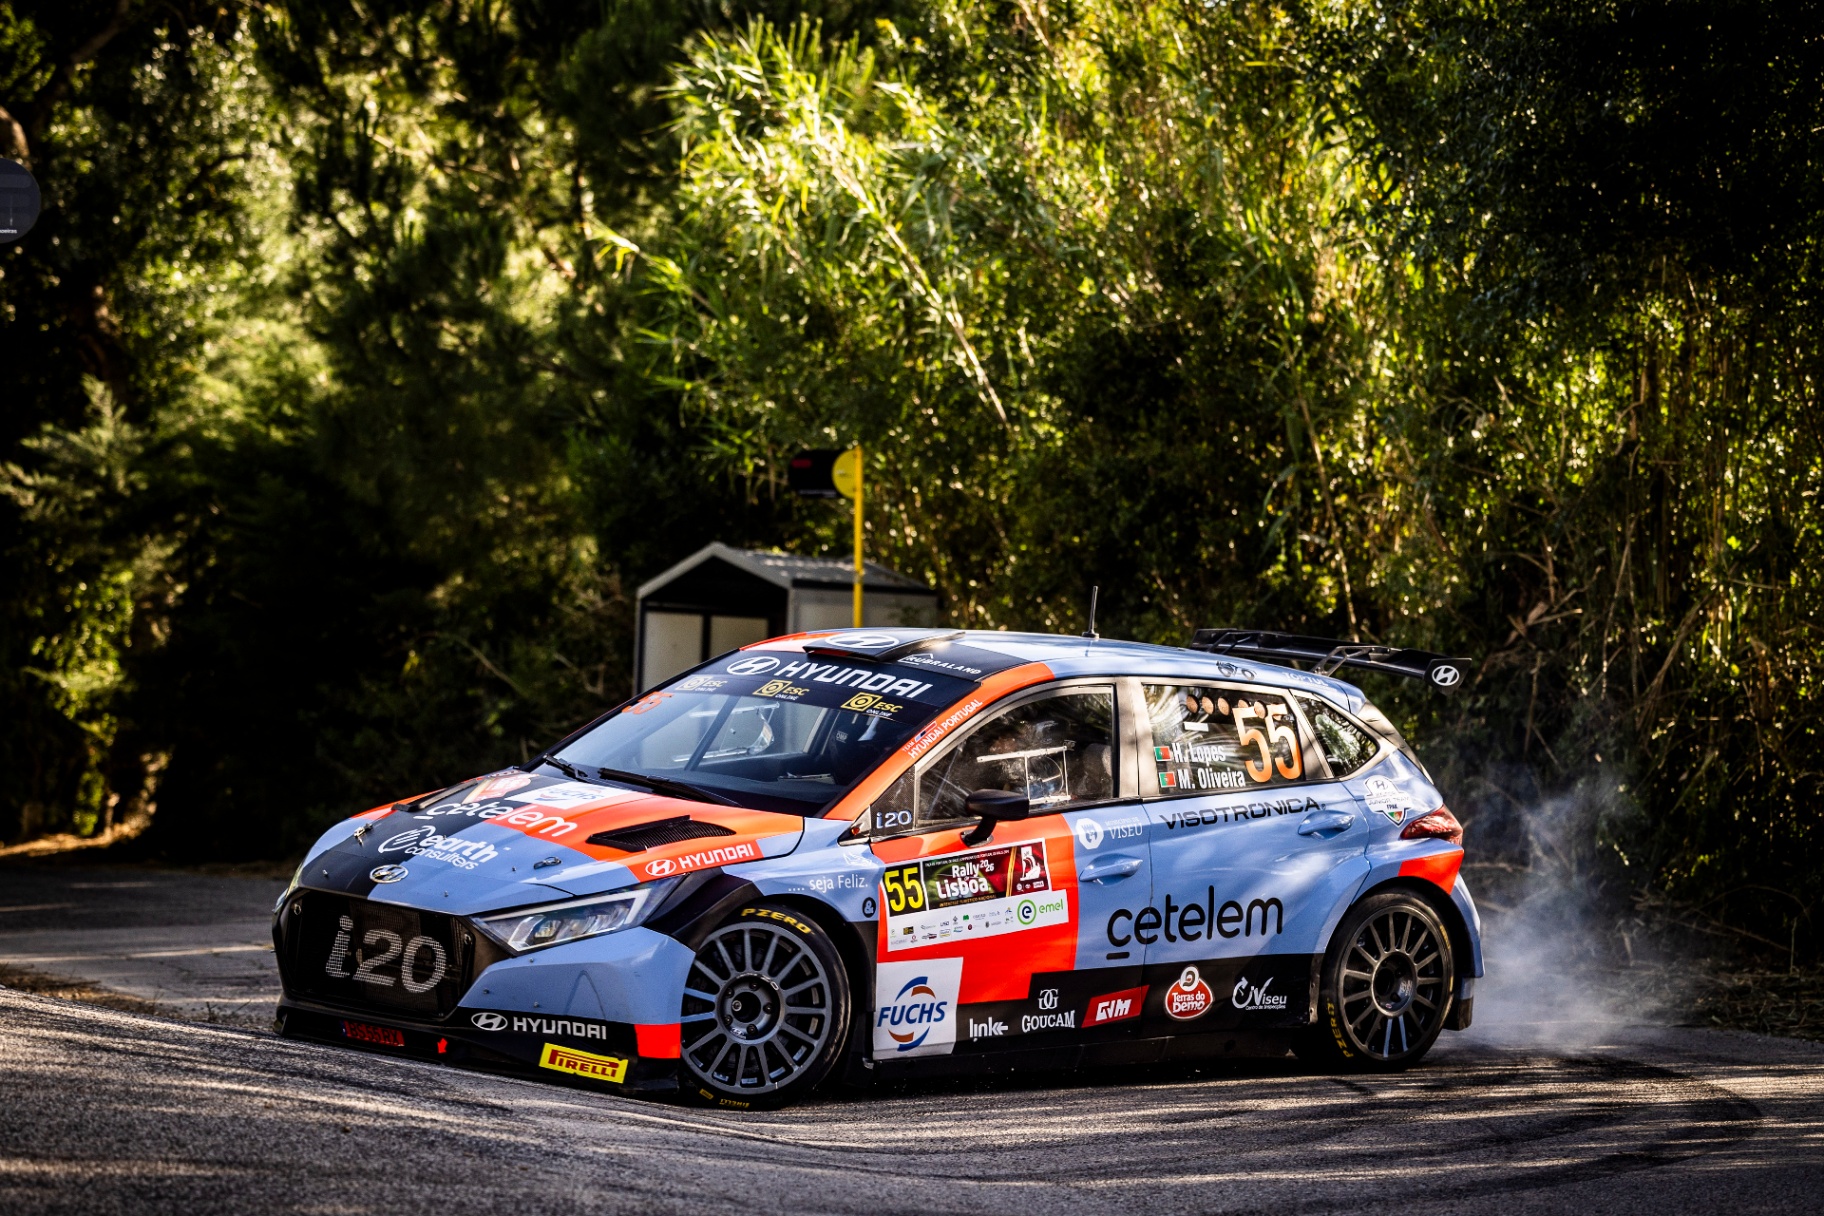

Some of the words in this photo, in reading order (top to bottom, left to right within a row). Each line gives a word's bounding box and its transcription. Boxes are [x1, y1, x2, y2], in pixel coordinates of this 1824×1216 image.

[774, 661, 933, 698] HYUNDAI
[783, 686, 810, 696] ESC
[875, 702, 903, 713] ESC
[908, 727, 944, 758] HYUNDAI
[941, 699, 983, 730] PORTUGAL
[1172, 742, 1187, 763] H.
[1189, 742, 1226, 767] Lopes
[1232, 703, 1303, 783] 55
[1178, 769, 1195, 789] M.
[1198, 767, 1246, 789] Oliveira
[426, 801, 577, 836] cetelem
[876, 810, 912, 829] i20
[1108, 823, 1142, 840] VISEU
[419, 835, 498, 862] earth
[679, 843, 754, 869] HYUNDAI
[952, 862, 979, 878] Rally
[810, 877, 834, 893] seja
[837, 873, 869, 889] Feliz.
[884, 867, 923, 912] 55
[936, 877, 989, 899] Lisboa
[1039, 898, 1063, 913] emel
[1107, 885, 1283, 949] cetelem
[326, 915, 446, 993] i20
[1172, 992, 1195, 1003] Terras
[1195, 991, 1205, 1000] do
[1173, 1001, 1206, 1013] Demo
[877, 1001, 947, 1027] FUCHS
[1022, 1010, 1075, 1033] GOUCAM
[513, 1016, 607, 1040] HYUNDAI
[548, 1049, 619, 1078] PIRELLI
